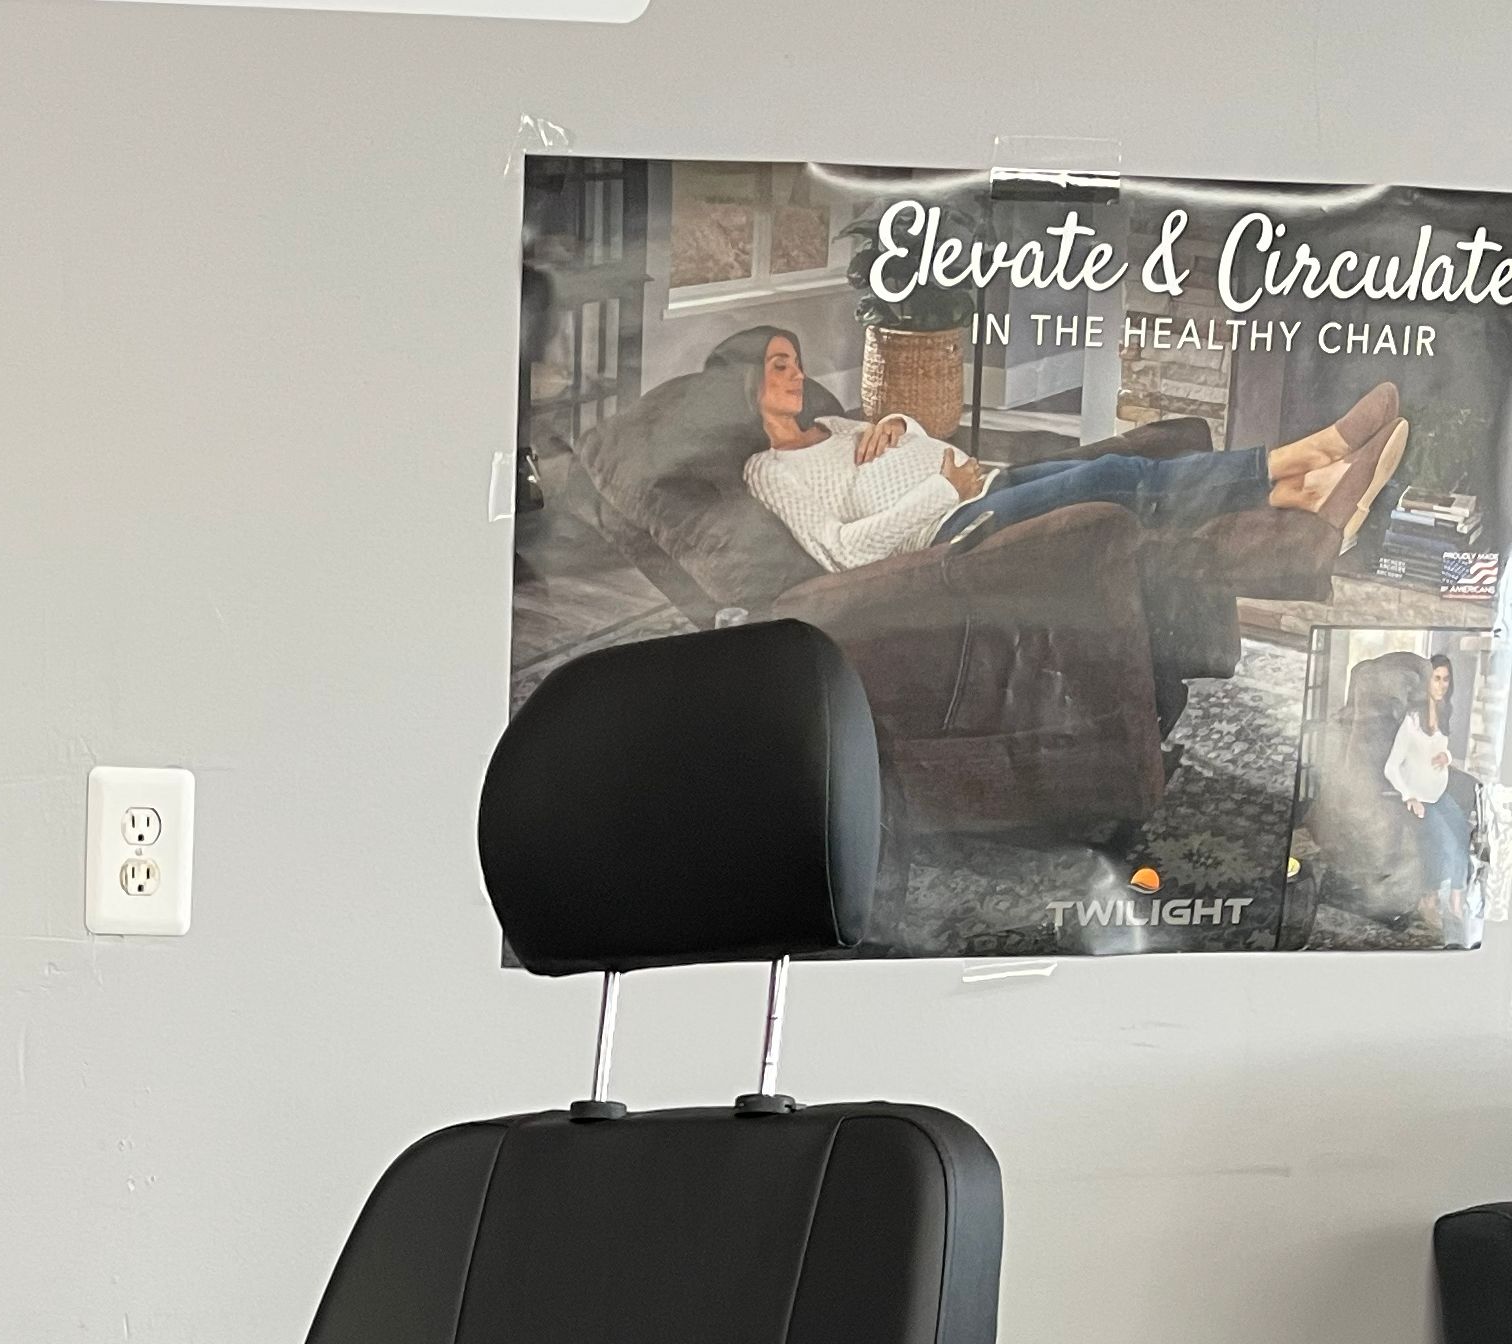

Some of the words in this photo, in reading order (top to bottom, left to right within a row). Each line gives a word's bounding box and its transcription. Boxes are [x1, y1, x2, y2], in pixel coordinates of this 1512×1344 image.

[869, 199, 1129, 304] Elevate
[1141, 209, 1190, 296] &
[1218, 212, 1512, 313] Circulate
[970, 313, 1011, 347] IN
[1030, 314, 1105, 348] THE
[1122, 317, 1303, 353] HEALTHY
[1317, 321, 1438, 358] CHAIR
[1045, 898, 1255, 928] TWILIGHT
